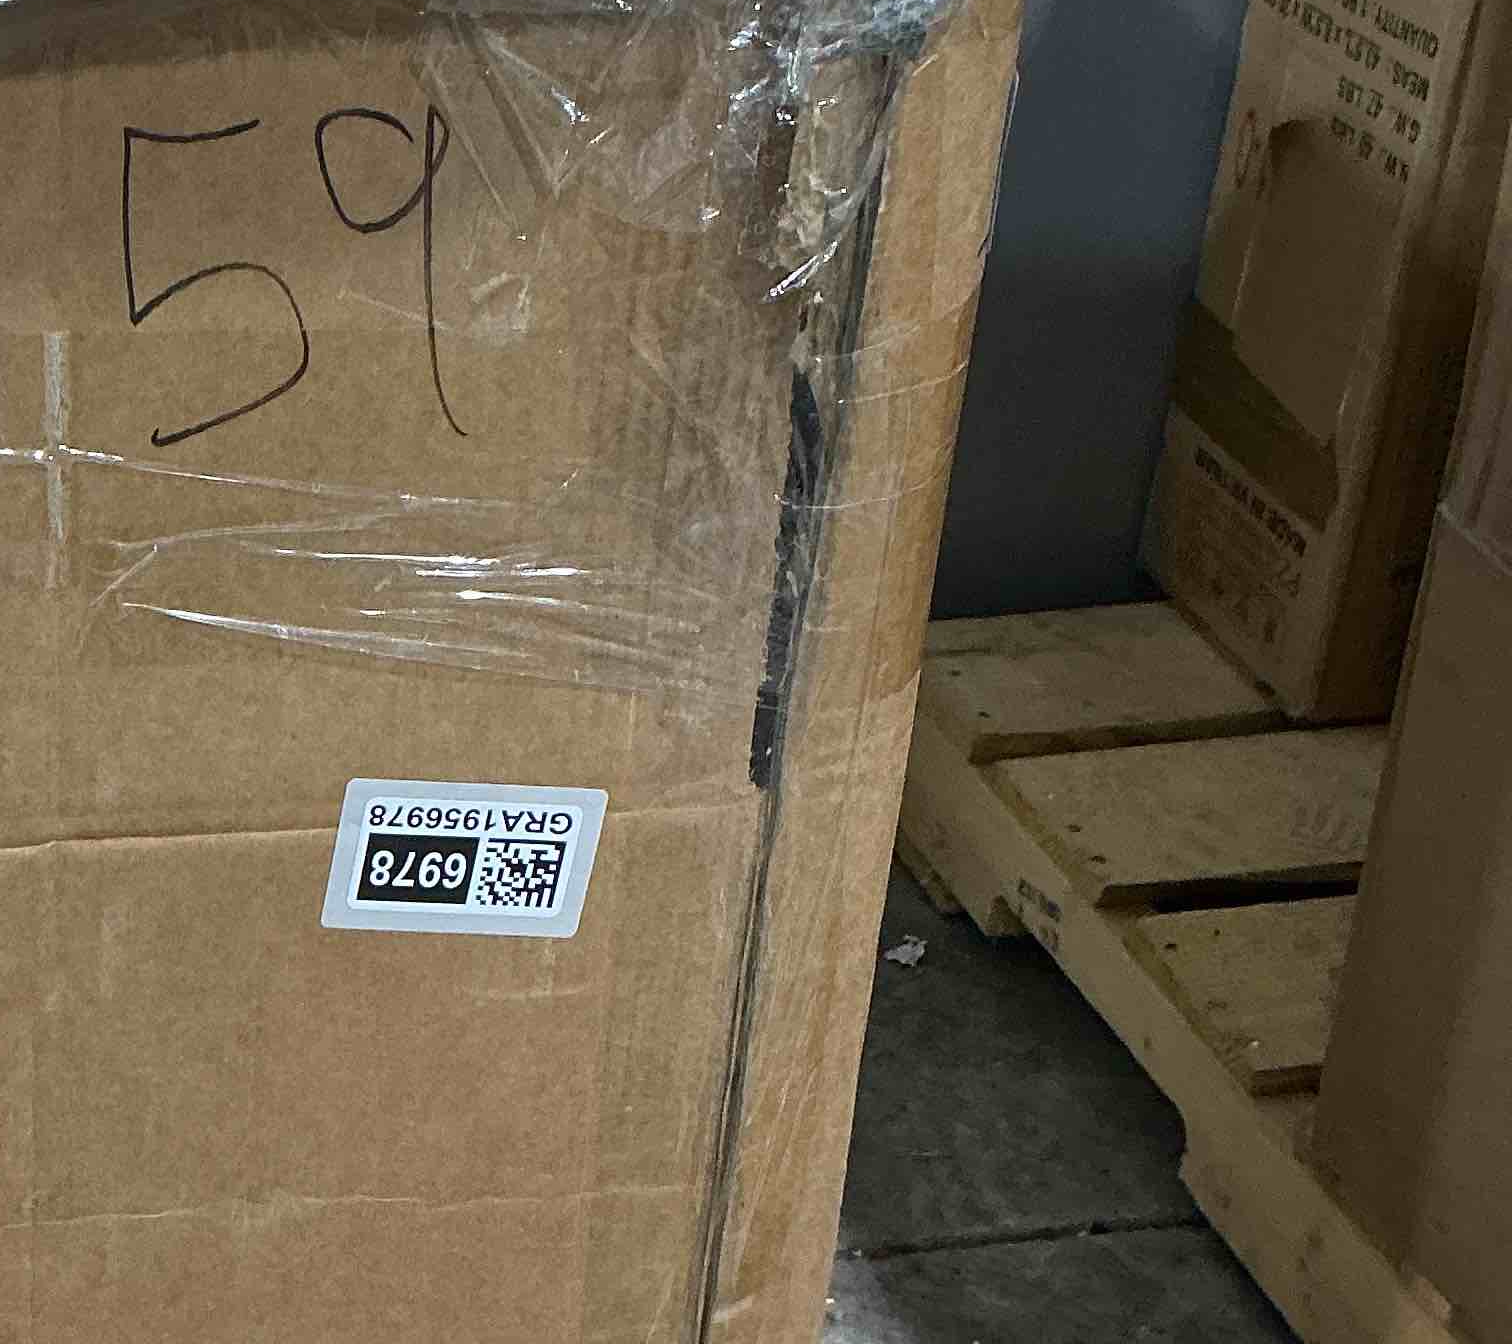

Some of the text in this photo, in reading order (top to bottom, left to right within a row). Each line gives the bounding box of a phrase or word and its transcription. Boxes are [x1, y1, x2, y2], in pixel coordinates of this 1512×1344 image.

[123, 104, 468, 447] 59
[369, 805, 573, 835] GRA1956978
[369, 850, 467, 889] 6978
